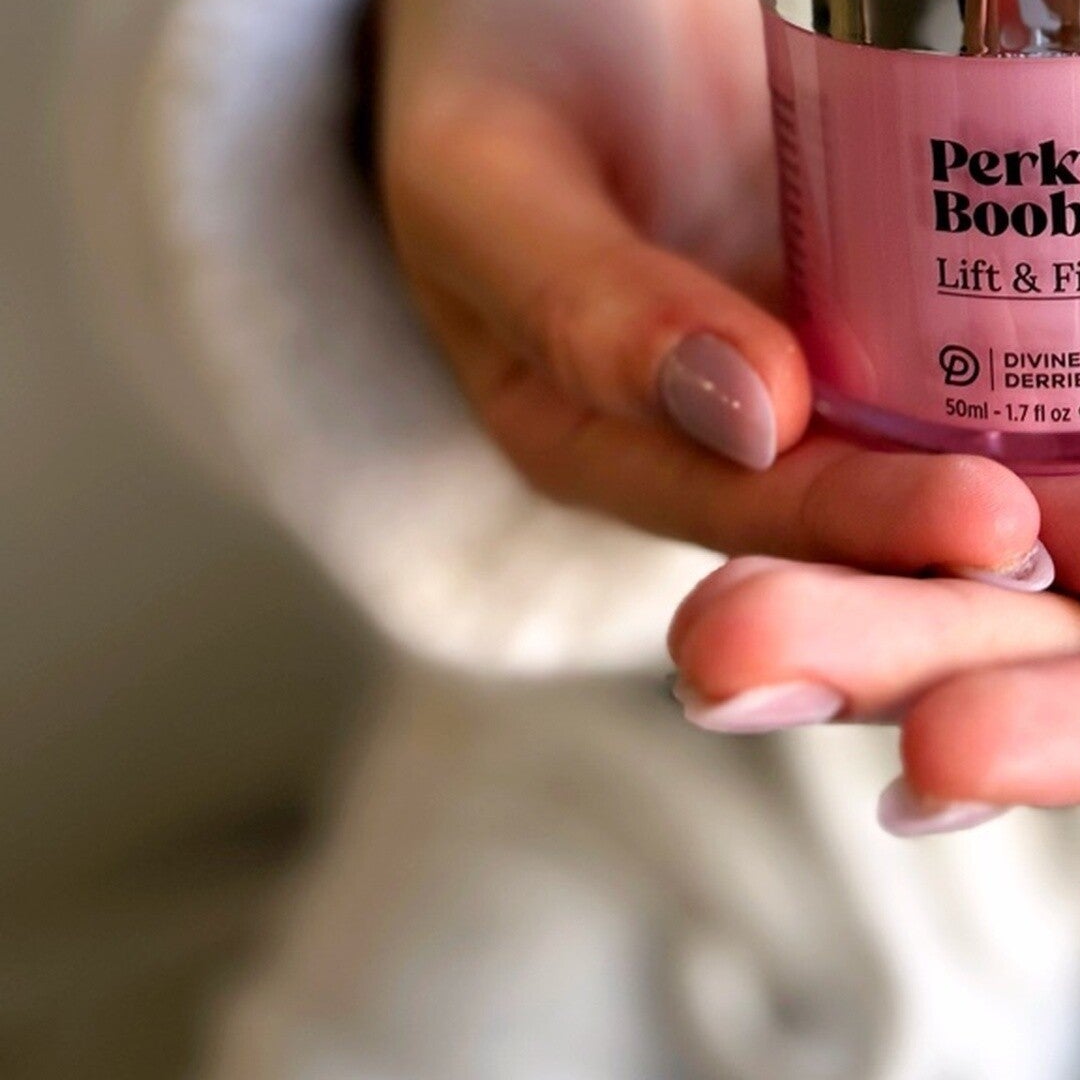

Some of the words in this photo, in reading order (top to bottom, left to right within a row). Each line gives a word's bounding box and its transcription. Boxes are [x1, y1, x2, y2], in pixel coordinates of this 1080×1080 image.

[936, 257, 1002, 292] Lift
[1012, 262, 1042, 294] &
[1003, 351, 1080, 369] DIVINE
[945, 397, 989, 420] 50ml
[1005, 403, 1030, 422] 1.7
[1034, 404, 1046, 422] fl
[1050, 406, 1072, 422] oz
